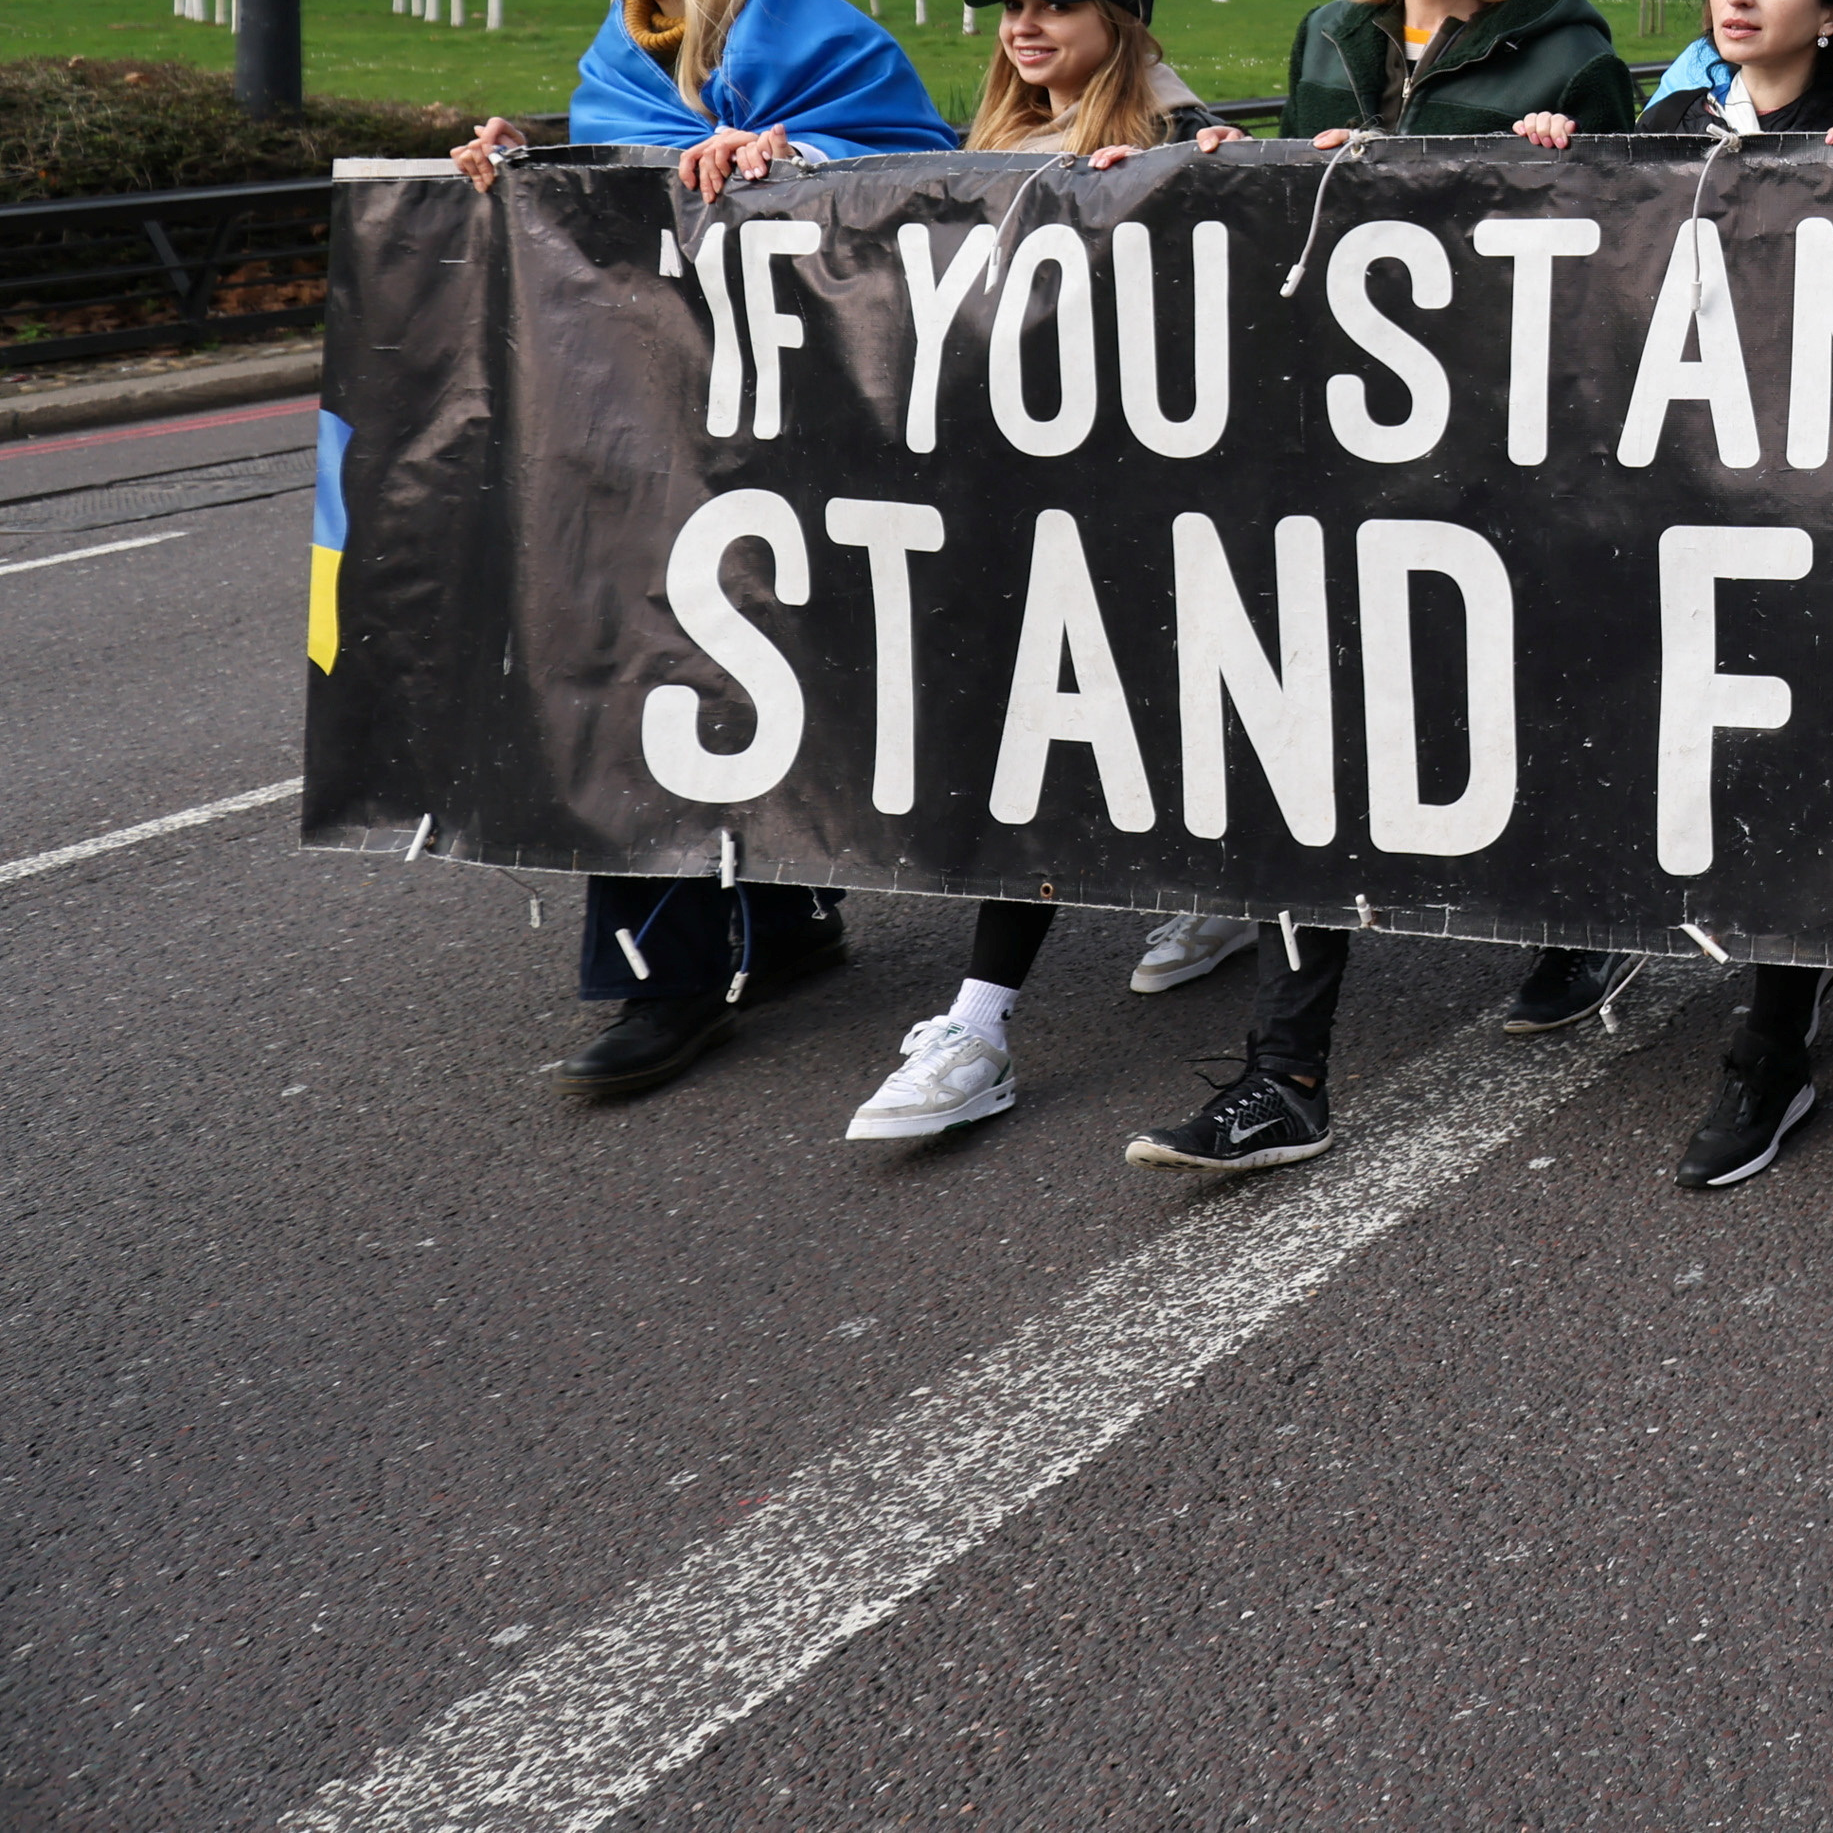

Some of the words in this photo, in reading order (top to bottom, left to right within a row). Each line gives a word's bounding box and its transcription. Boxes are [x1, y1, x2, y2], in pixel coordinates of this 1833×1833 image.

[692, 219, 823, 440] IF
[900, 221, 1230, 459] YOU
[641, 488, 1519, 856] STAND
